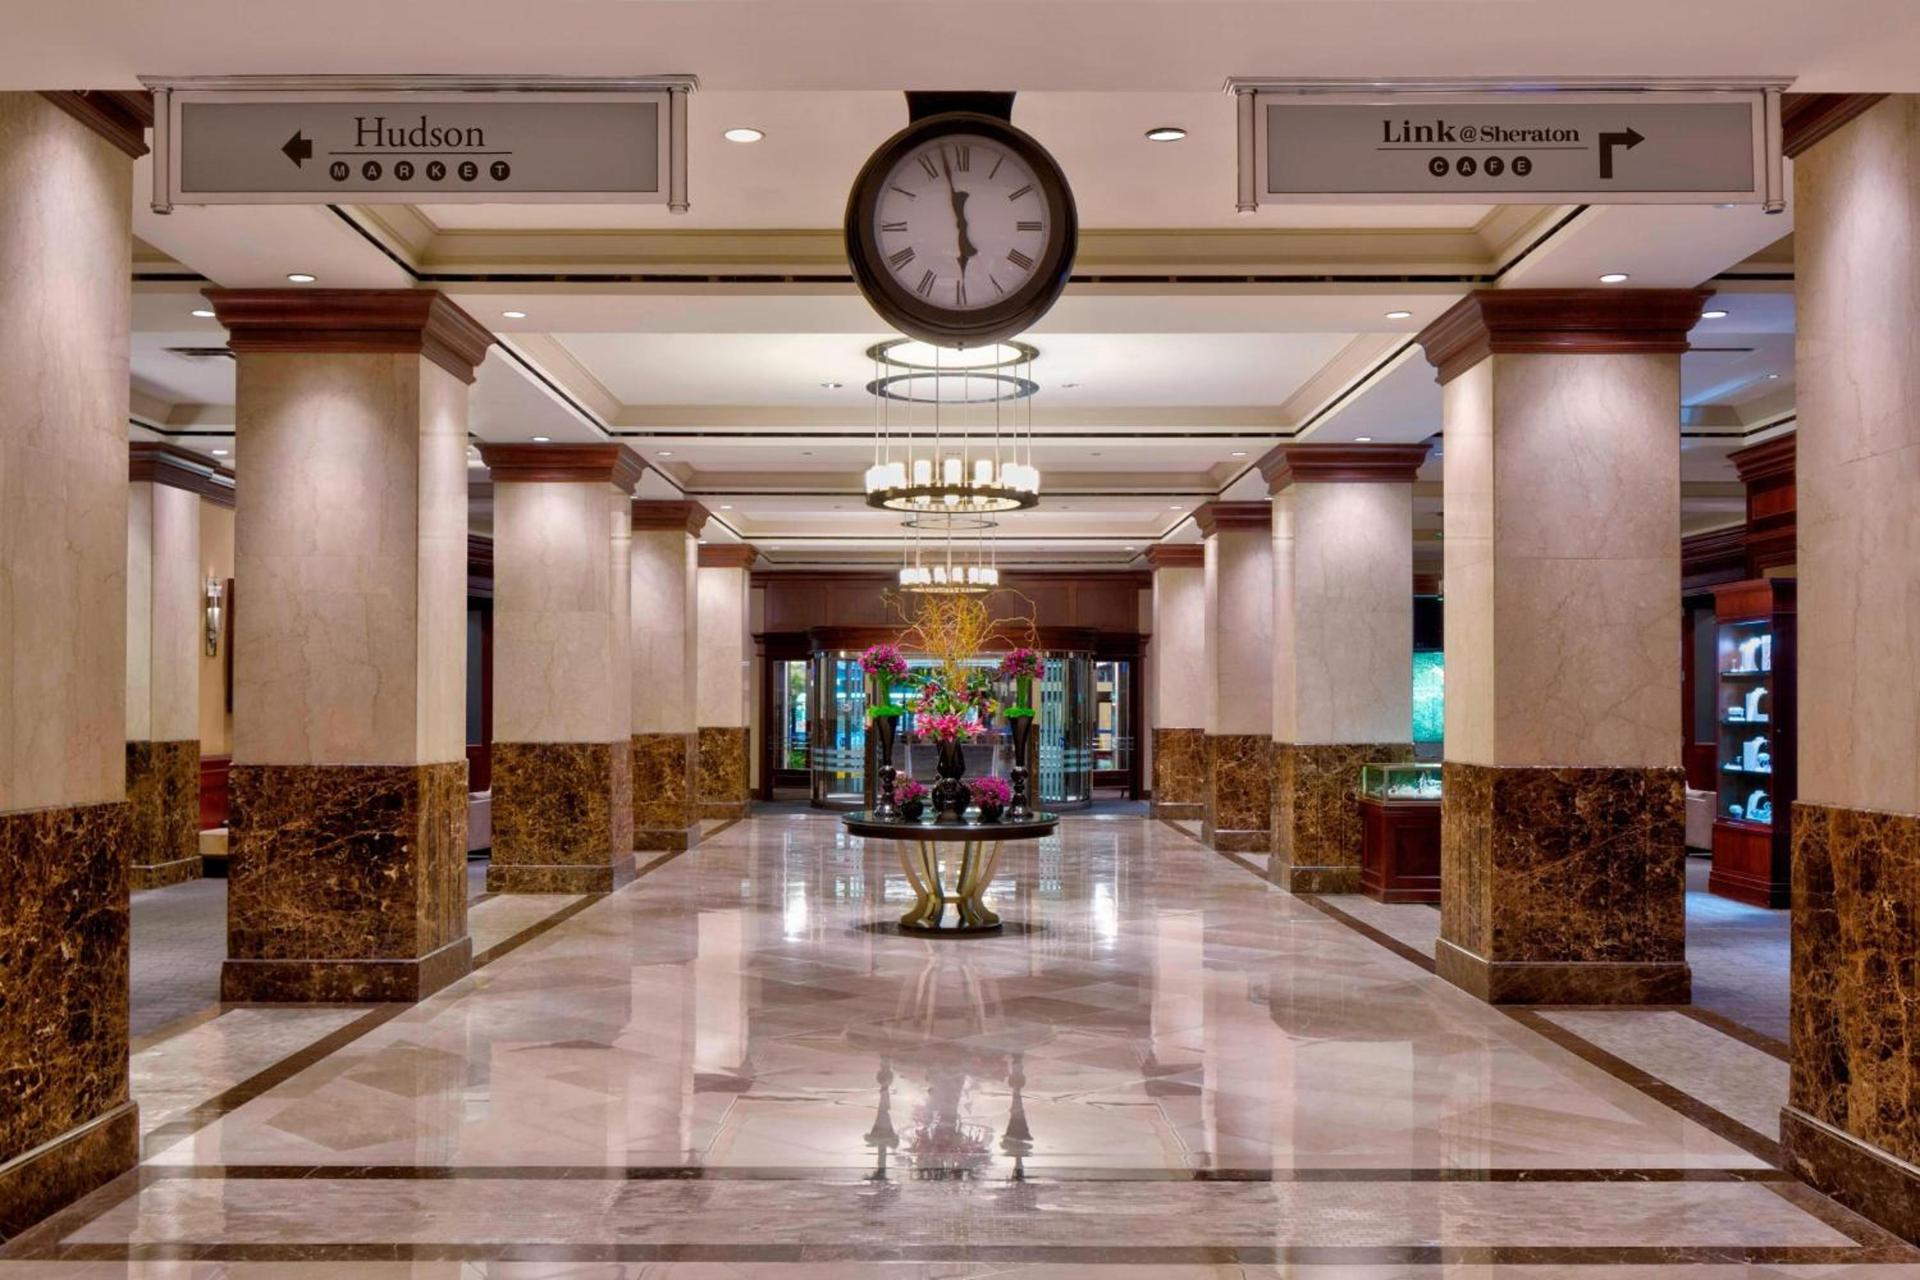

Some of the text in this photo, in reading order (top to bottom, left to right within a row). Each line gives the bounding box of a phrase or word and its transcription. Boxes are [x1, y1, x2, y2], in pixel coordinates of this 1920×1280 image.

[354, 115, 486, 147] Hudson
[331, 162, 509, 179] MARKET
[1430, 158, 1530, 175] CAFE
